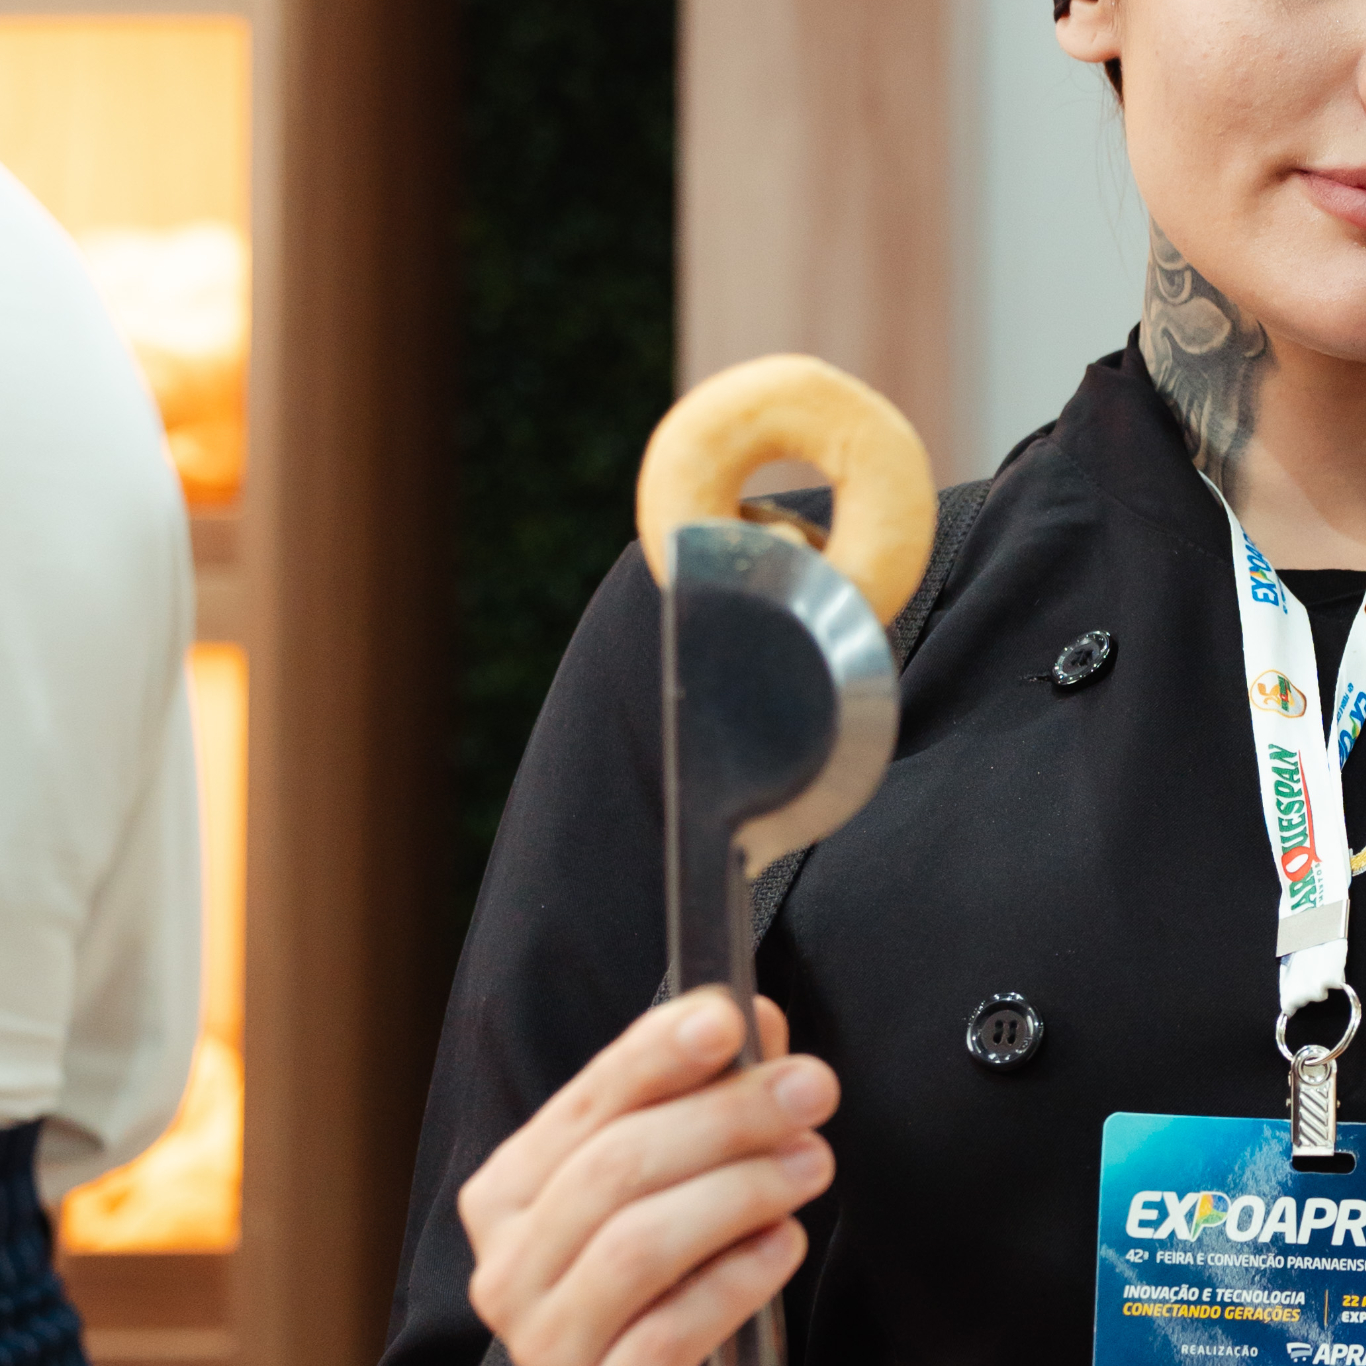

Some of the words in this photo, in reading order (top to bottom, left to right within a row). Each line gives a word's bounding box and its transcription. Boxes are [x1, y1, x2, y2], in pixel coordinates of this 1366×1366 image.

[1268, 743, 1322, 912] ARQUESPAN
[1156, 1251, 1194, 1265] FEIRA
[1196, 1252, 1205, 1266] E
[1207, 1251, 1285, 1270] CONVENÇÃO
[1123, 1283, 1200, 1304] INOVAÇÃO
[1202, 1287, 1213, 1302] E
[1215, 1288, 1306, 1306] TECNOLOGIA
[1342, 1295, 1360, 1307] 22
[1122, 1301, 1222, 1320] CONECTANDO
[1224, 1304, 1301, 1324] GERAÇÕES
[1181, 1343, 1259, 1358] REALIZAÇÃO
